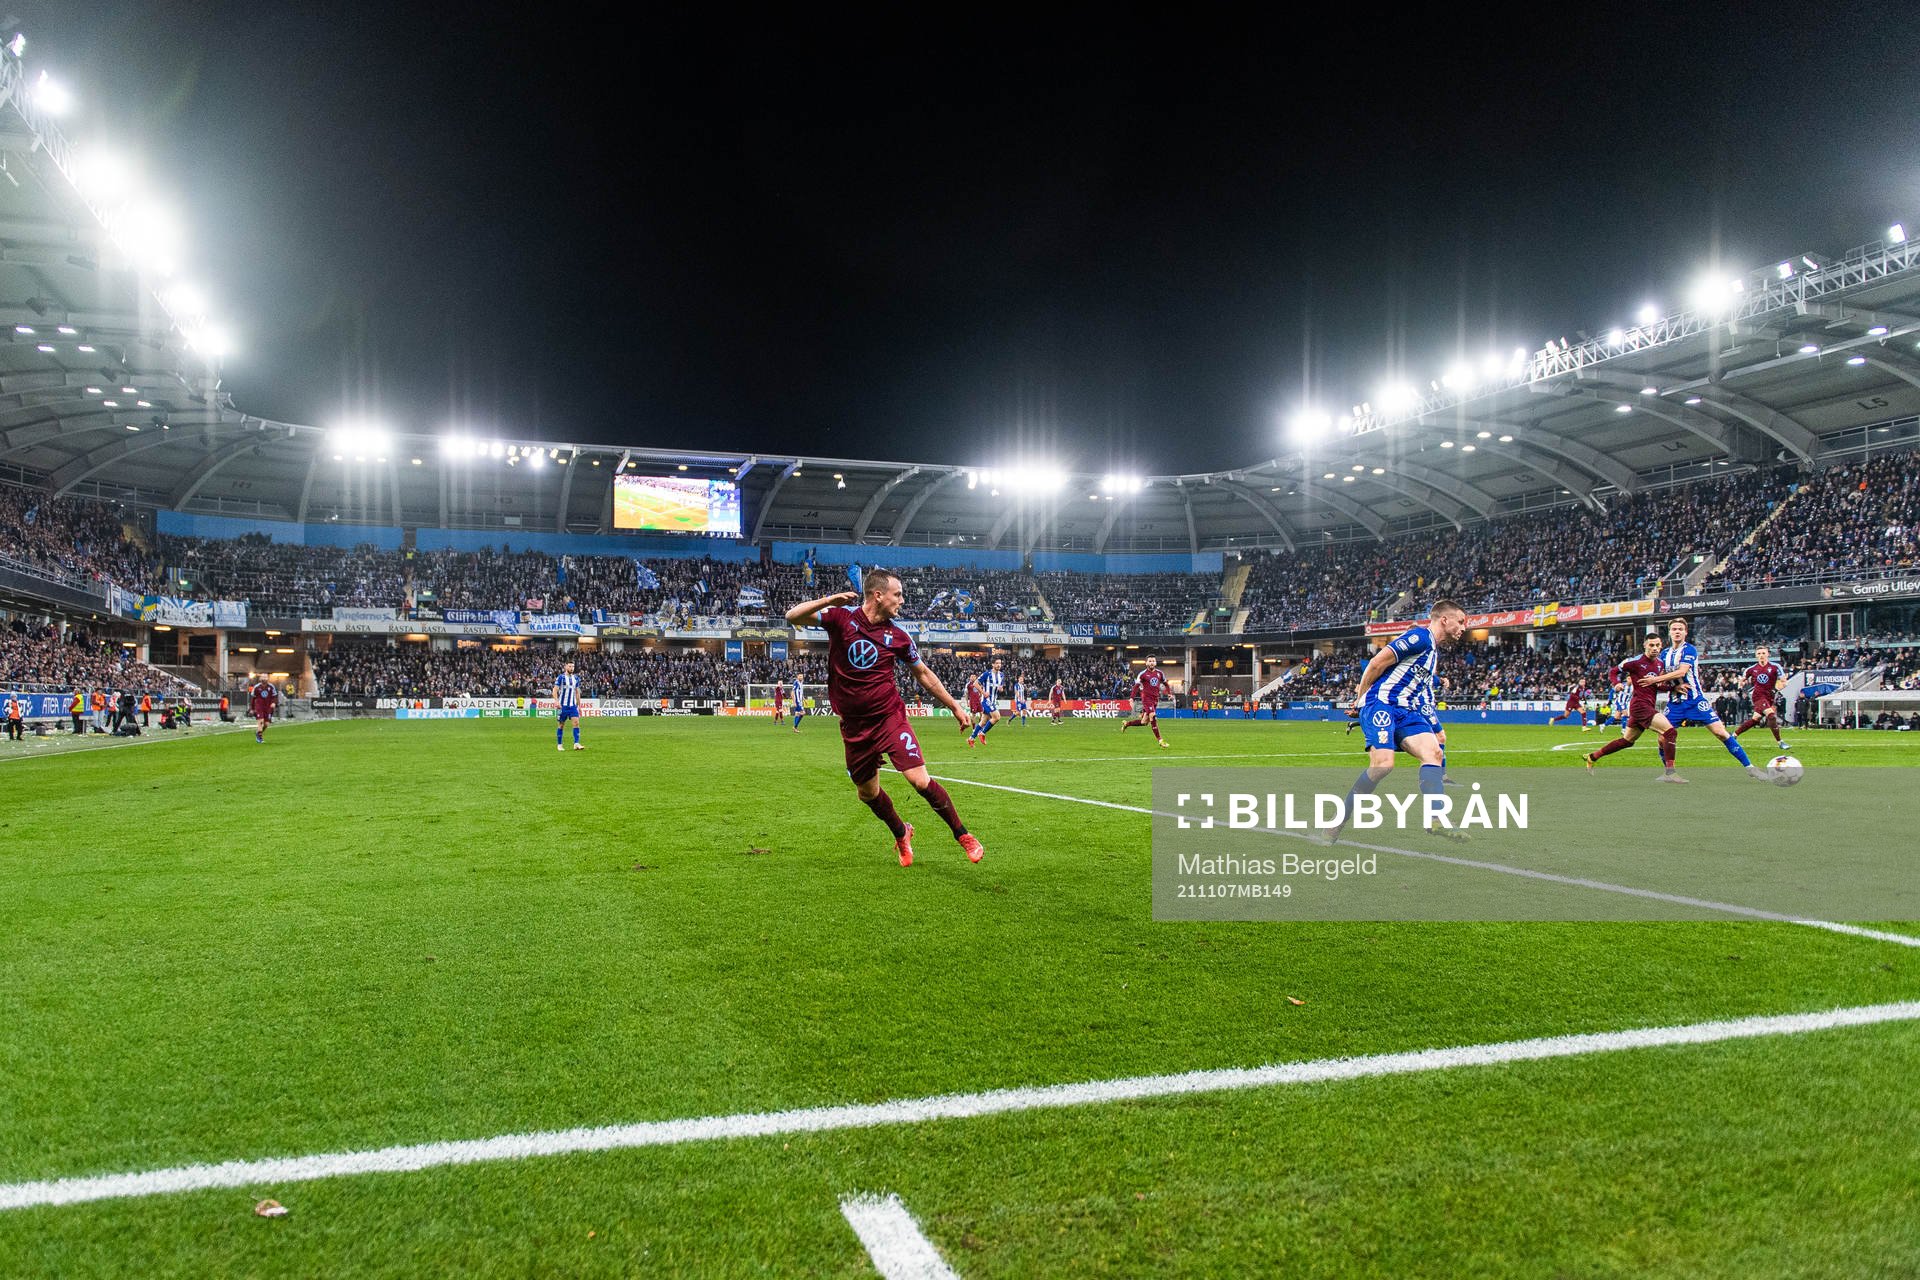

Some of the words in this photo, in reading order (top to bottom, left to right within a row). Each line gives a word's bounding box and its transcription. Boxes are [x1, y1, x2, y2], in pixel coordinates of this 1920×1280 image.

[1857, 397, 1889, 410] L5
[1852, 584, 1889, 595] Gamla
[312, 624, 337, 632] RASTA
[388, 625, 414, 633] RASTA
[1071, 624, 1094, 636] WISE
[1101, 625, 1119, 636] MEN
[602, 700, 634, 709] ATEA
[900, 732, 917, 750] 2
